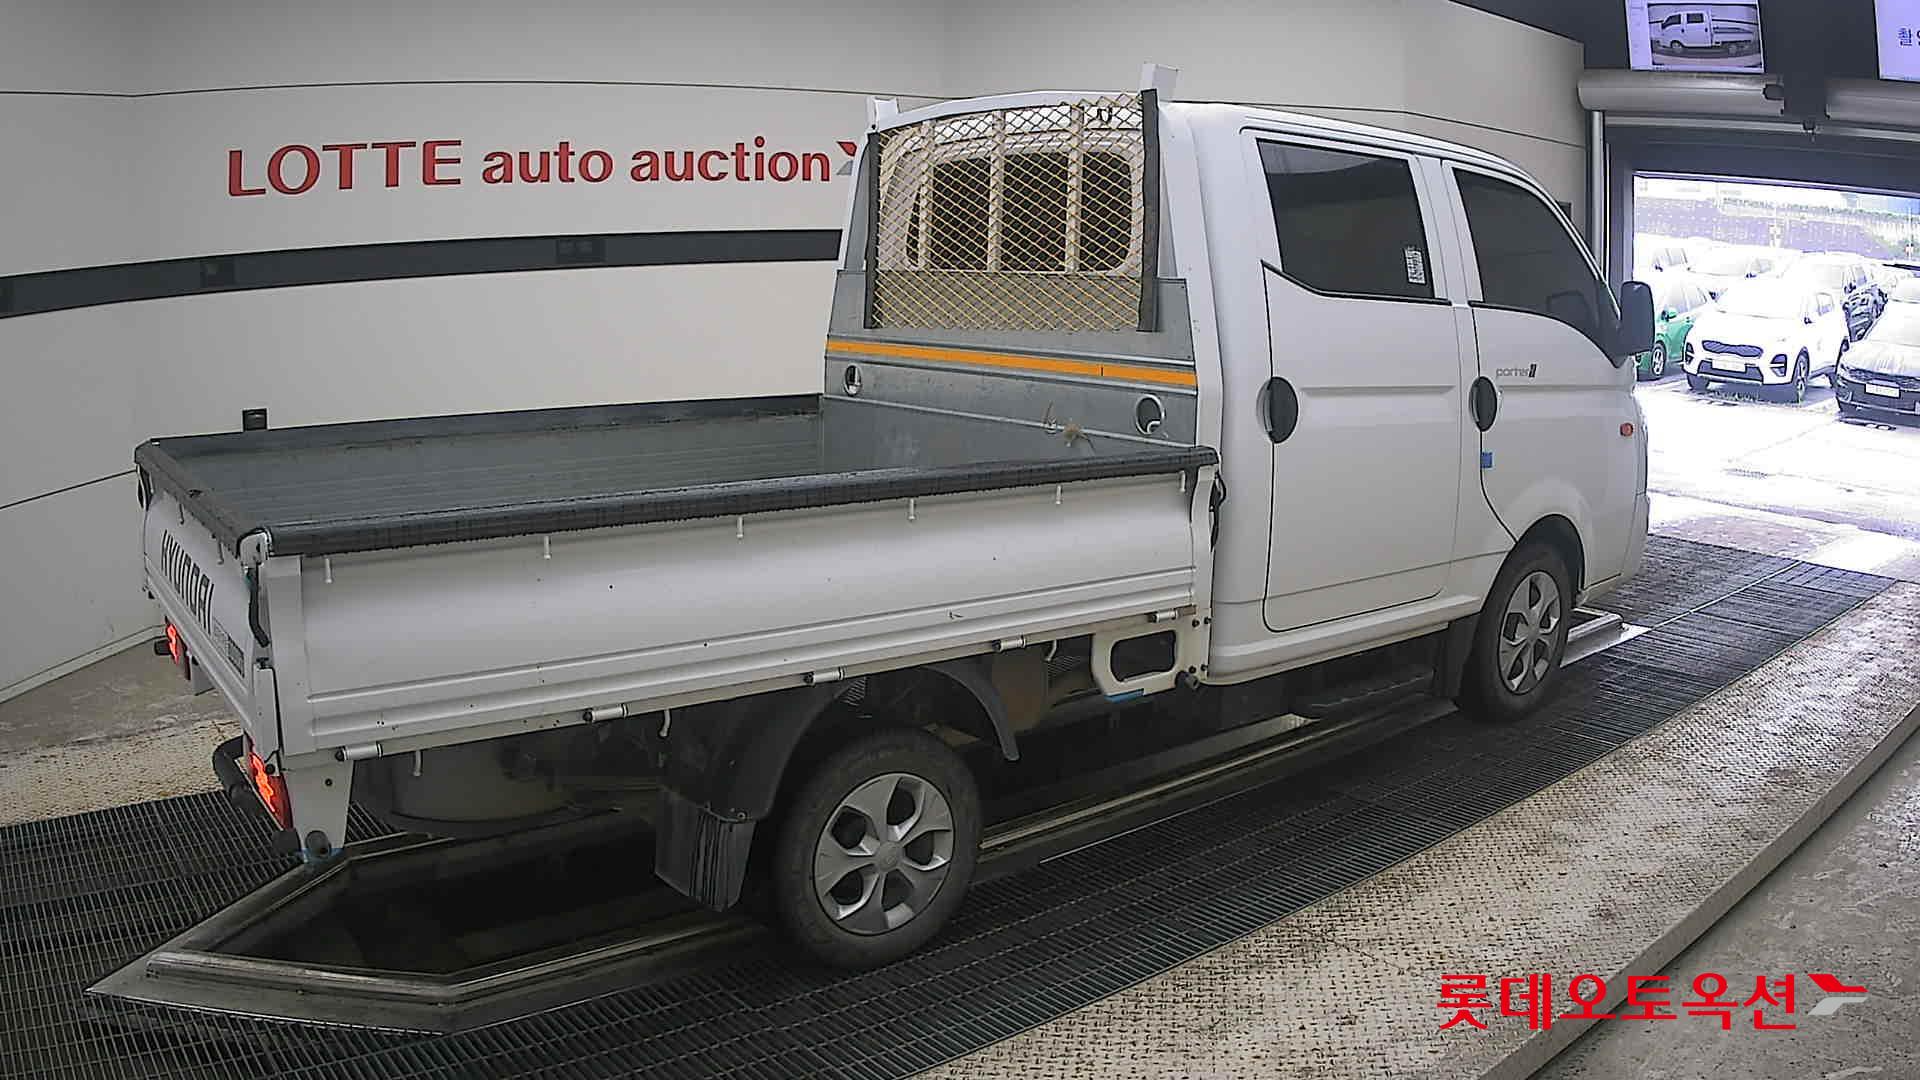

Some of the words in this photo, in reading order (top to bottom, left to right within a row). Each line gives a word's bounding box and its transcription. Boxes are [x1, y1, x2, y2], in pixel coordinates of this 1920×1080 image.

[228, 139, 462, 197] LOTTE
[482, 141, 613, 184] auto
[630, 136, 831, 182] auction
[161, 529, 214, 636] HYUNDAI
